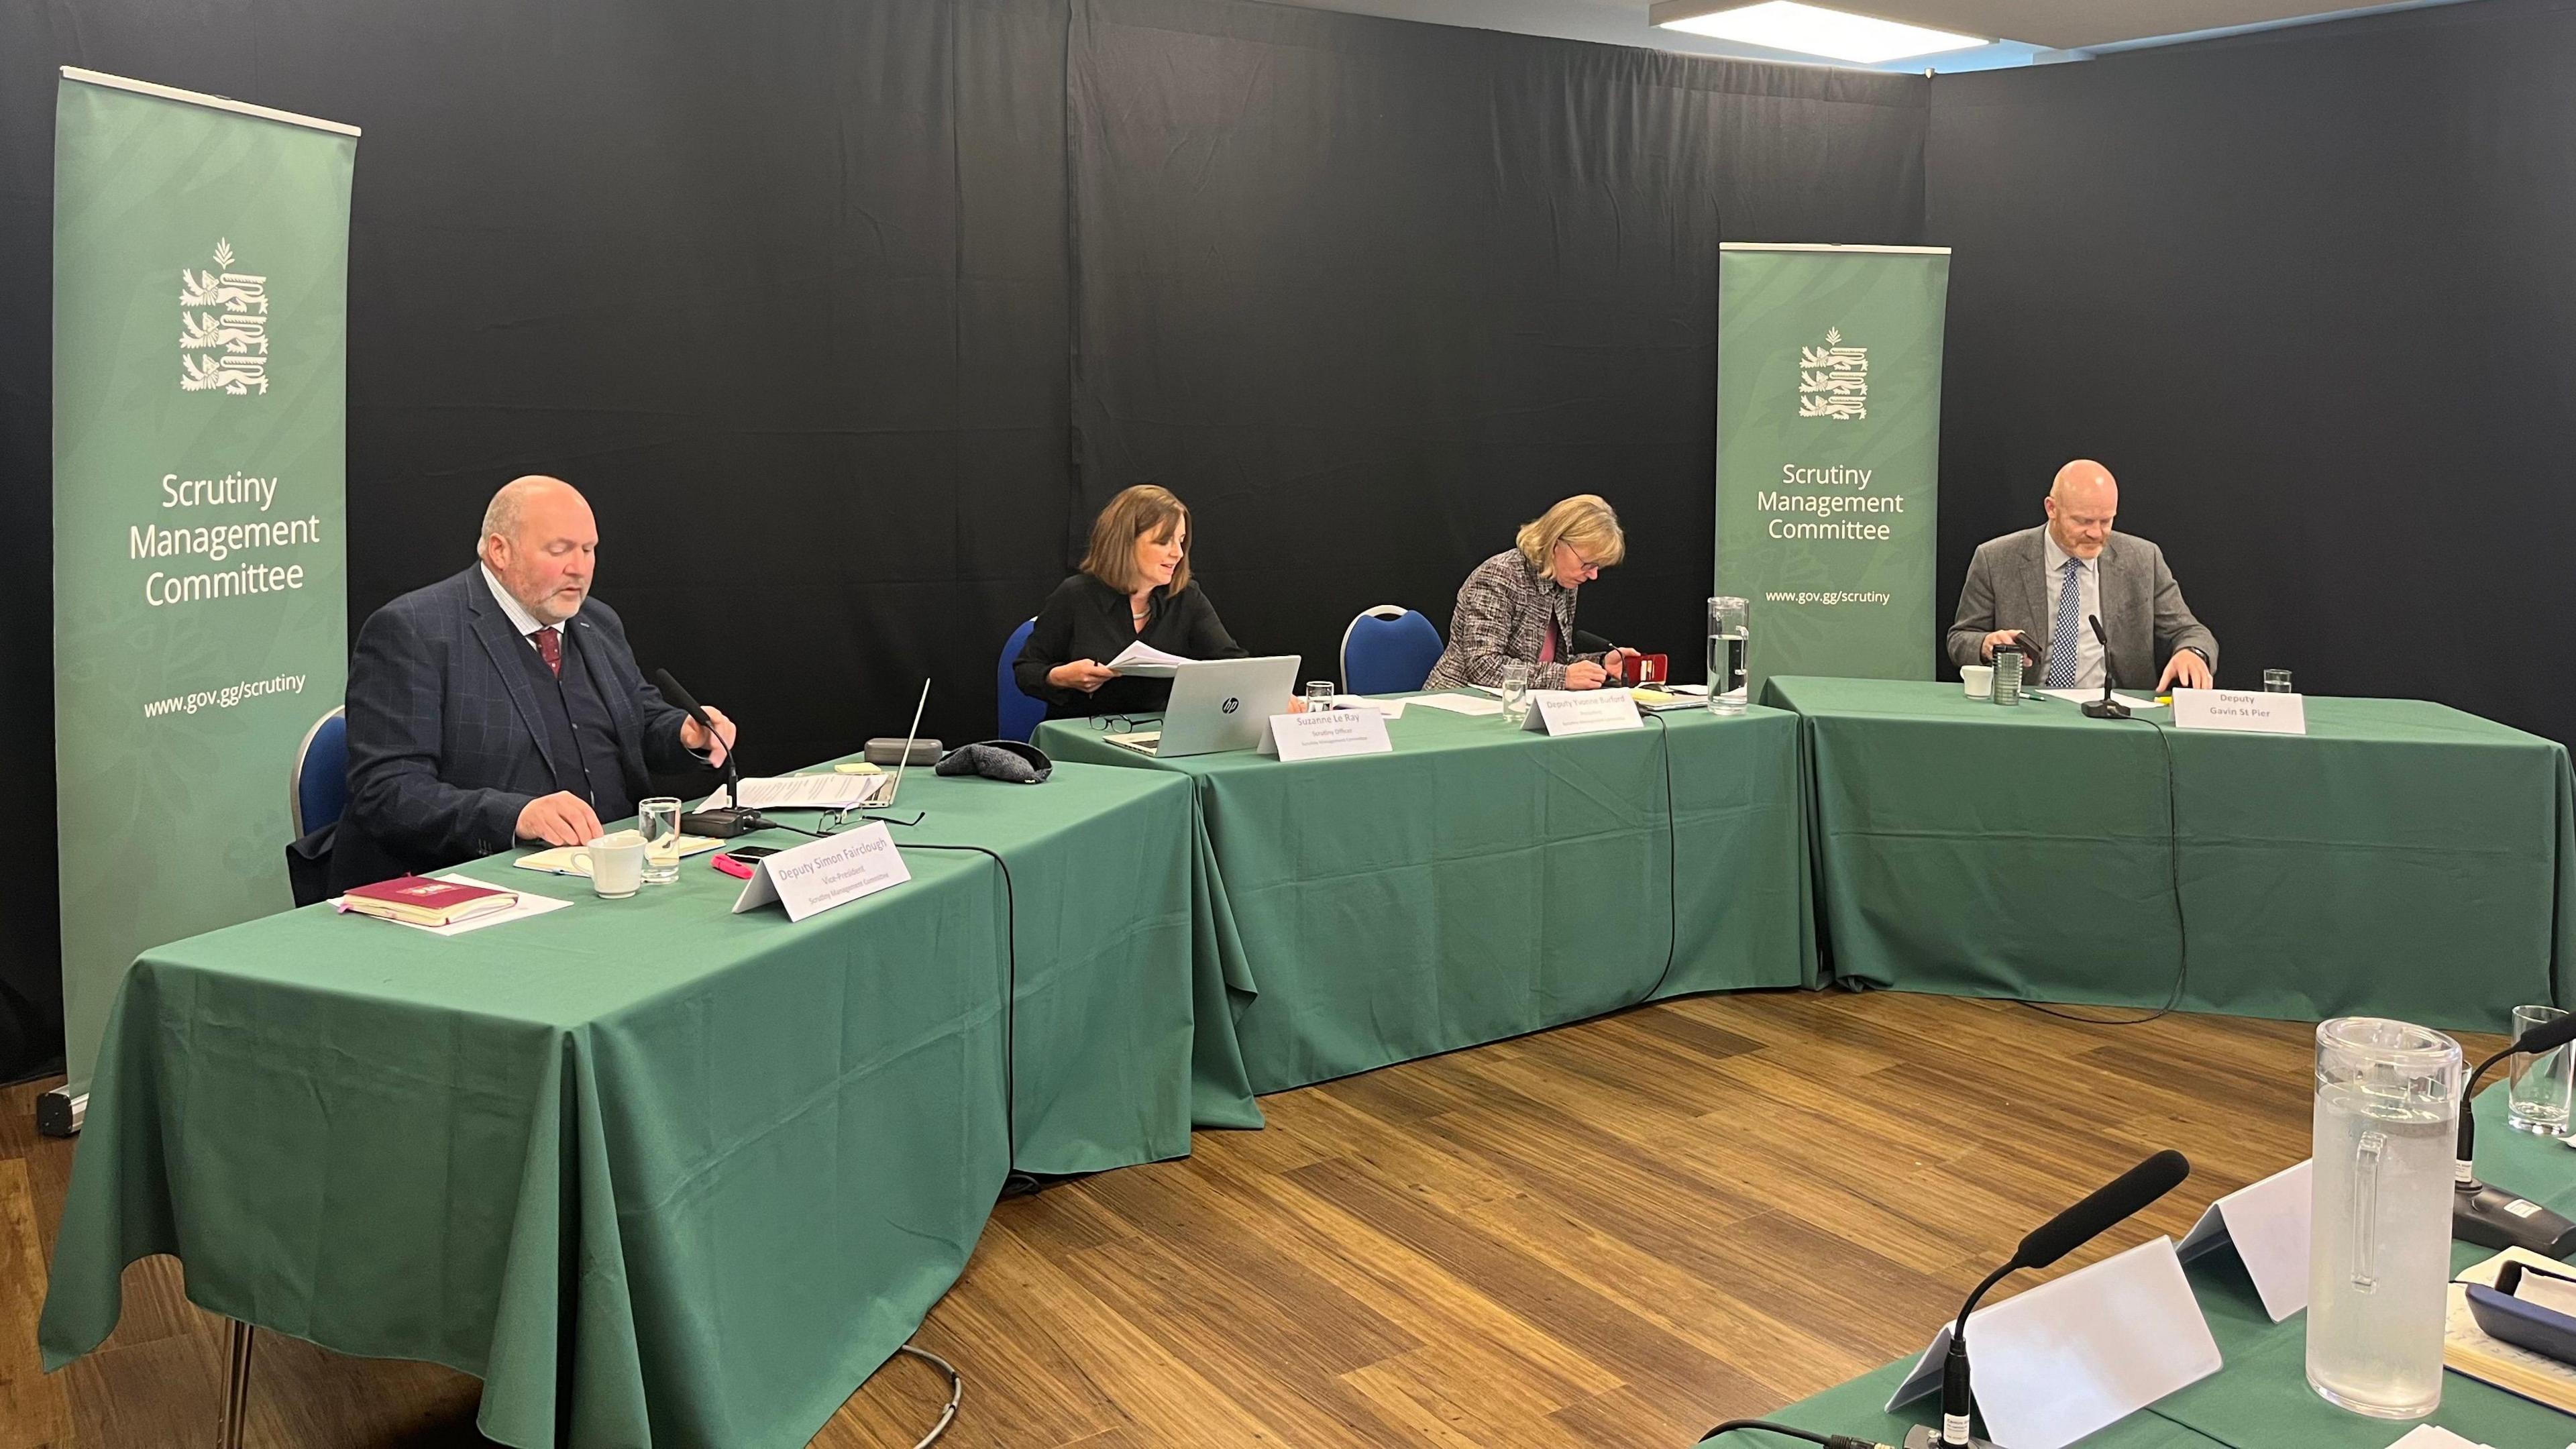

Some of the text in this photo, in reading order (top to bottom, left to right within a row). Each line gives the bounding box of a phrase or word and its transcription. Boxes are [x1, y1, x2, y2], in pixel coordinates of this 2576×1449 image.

[1782, 464, 1872, 490] Scrutiny
[162, 472, 278, 511] Scrutiny
[1757, 491, 1904, 517] Management
[129, 514, 320, 561] Management
[1768, 519, 1890, 541] Committee
[146, 563, 305, 607] Committee
[1765, 590, 1890, 606] www.gov.gg/scrutiny
[144, 673, 305, 718] www.gov.gg/scrutiny
[1223, 698, 1238, 714] hp
[1546, 700, 1572, 709] Deputy
[2220, 694, 2255, 704] Deputy
[1297, 713, 1360, 726] Suzanne Le Ray
[2210, 707, 2271, 717] Gavin St Pier
[779, 838, 887, 881] Deputy Simon Fairclough
[821, 865, 865, 885] Vice-President
